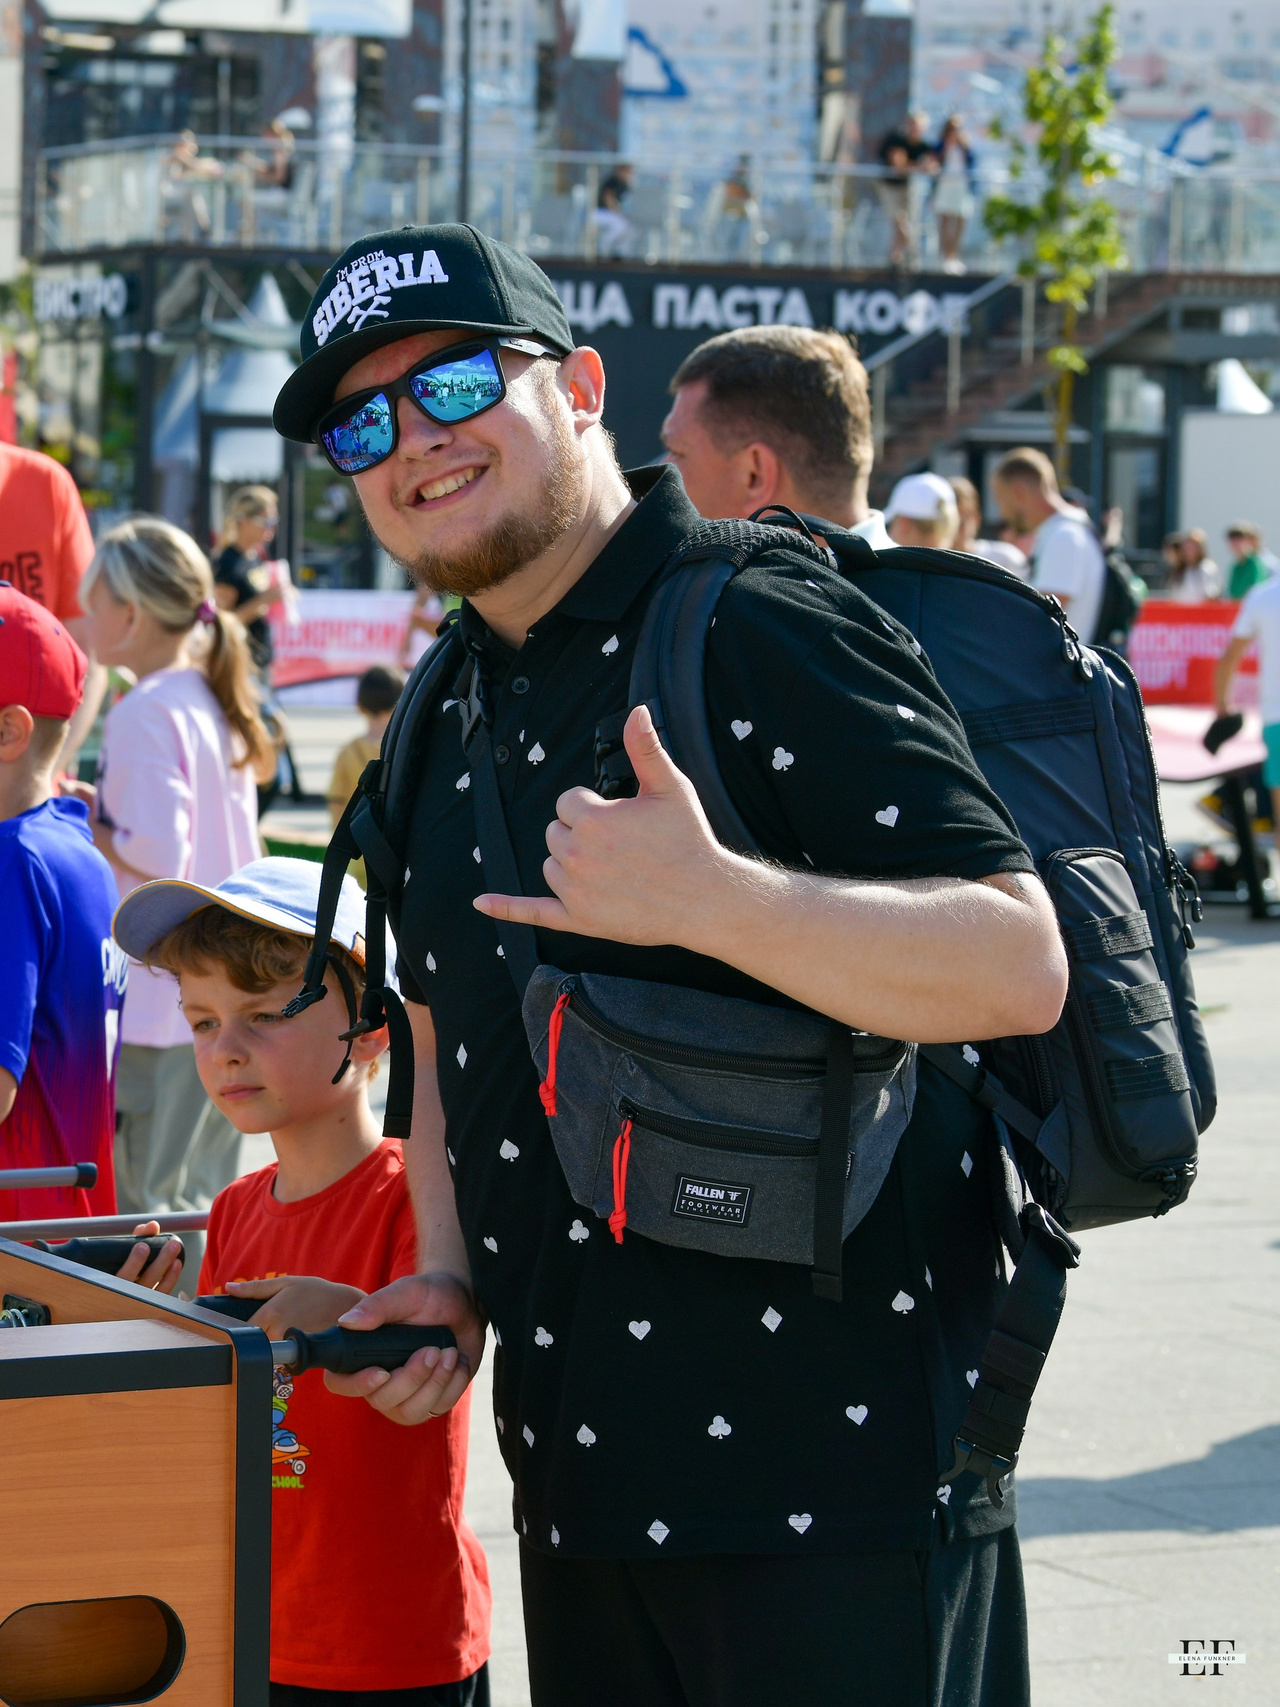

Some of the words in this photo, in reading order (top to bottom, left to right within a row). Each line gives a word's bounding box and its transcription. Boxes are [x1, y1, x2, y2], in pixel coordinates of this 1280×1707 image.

[312, 249, 450, 347] SIBERIA
[554, 281, 633, 332] ЦА
[651, 283, 816, 329] ПАСТА
[833, 288, 970, 335] КОФЕ
[685, 1184, 725, 1200] FALLEN
[680, 1205, 710, 1214] SINCE
[681, 1199, 741, 1214] FOOTWEAR
